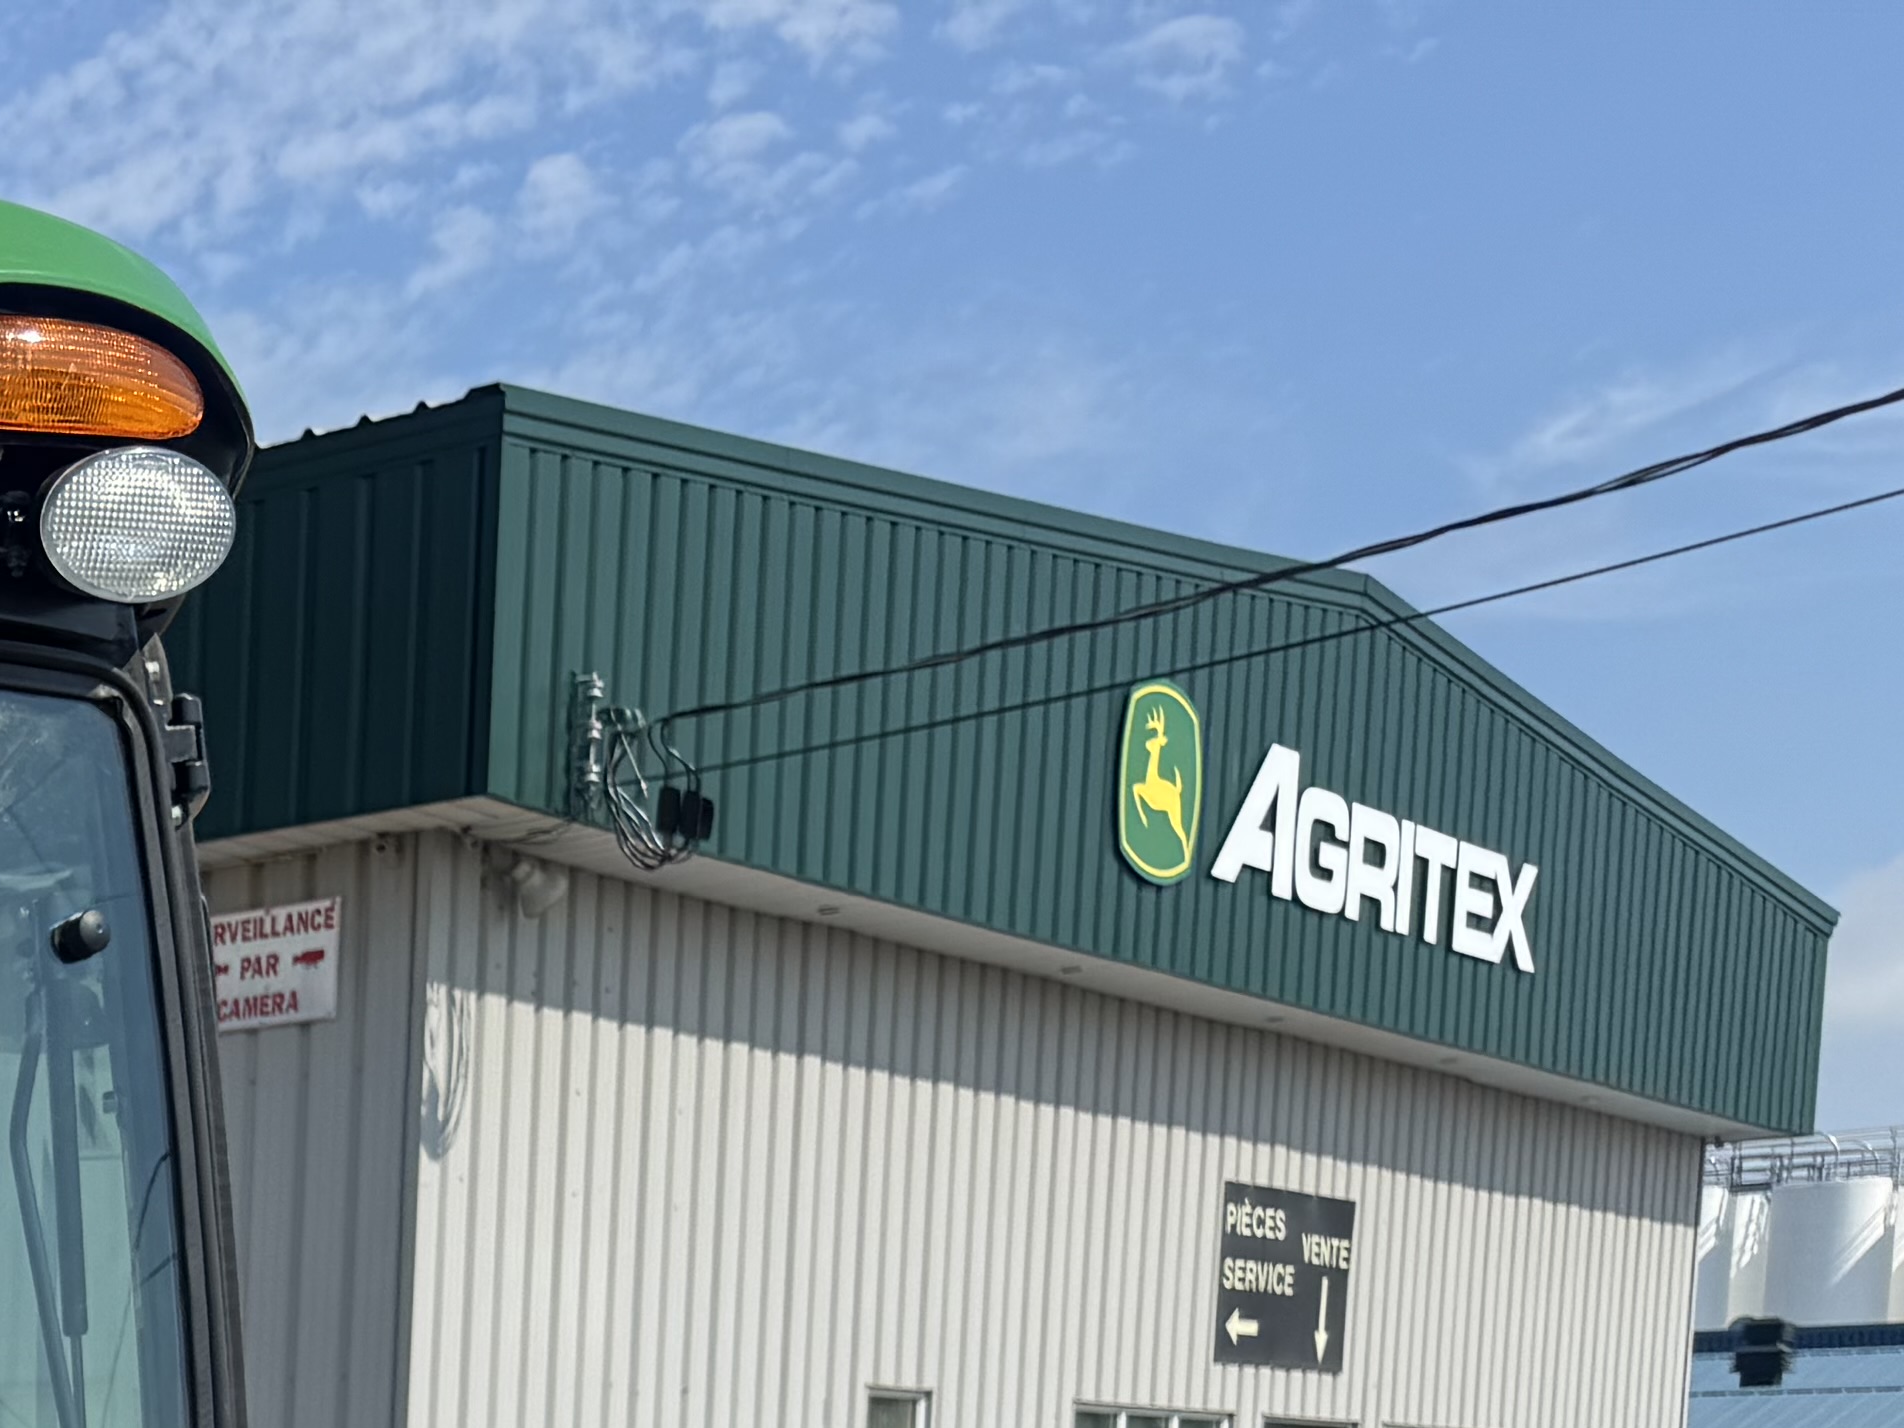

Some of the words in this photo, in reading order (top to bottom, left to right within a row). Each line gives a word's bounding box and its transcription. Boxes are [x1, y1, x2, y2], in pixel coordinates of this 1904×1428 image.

[1210, 743, 1539, 974] AGRITEX
[213, 905, 335, 946] RVEILLANCE
[239, 953, 280, 980] PAR
[217, 990, 299, 1023] CAMERA
[1225, 1196, 1287, 1241] PIÈCES
[1301, 1232, 1351, 1270] VENTE
[1222, 1256, 1295, 1297] SERVICE
